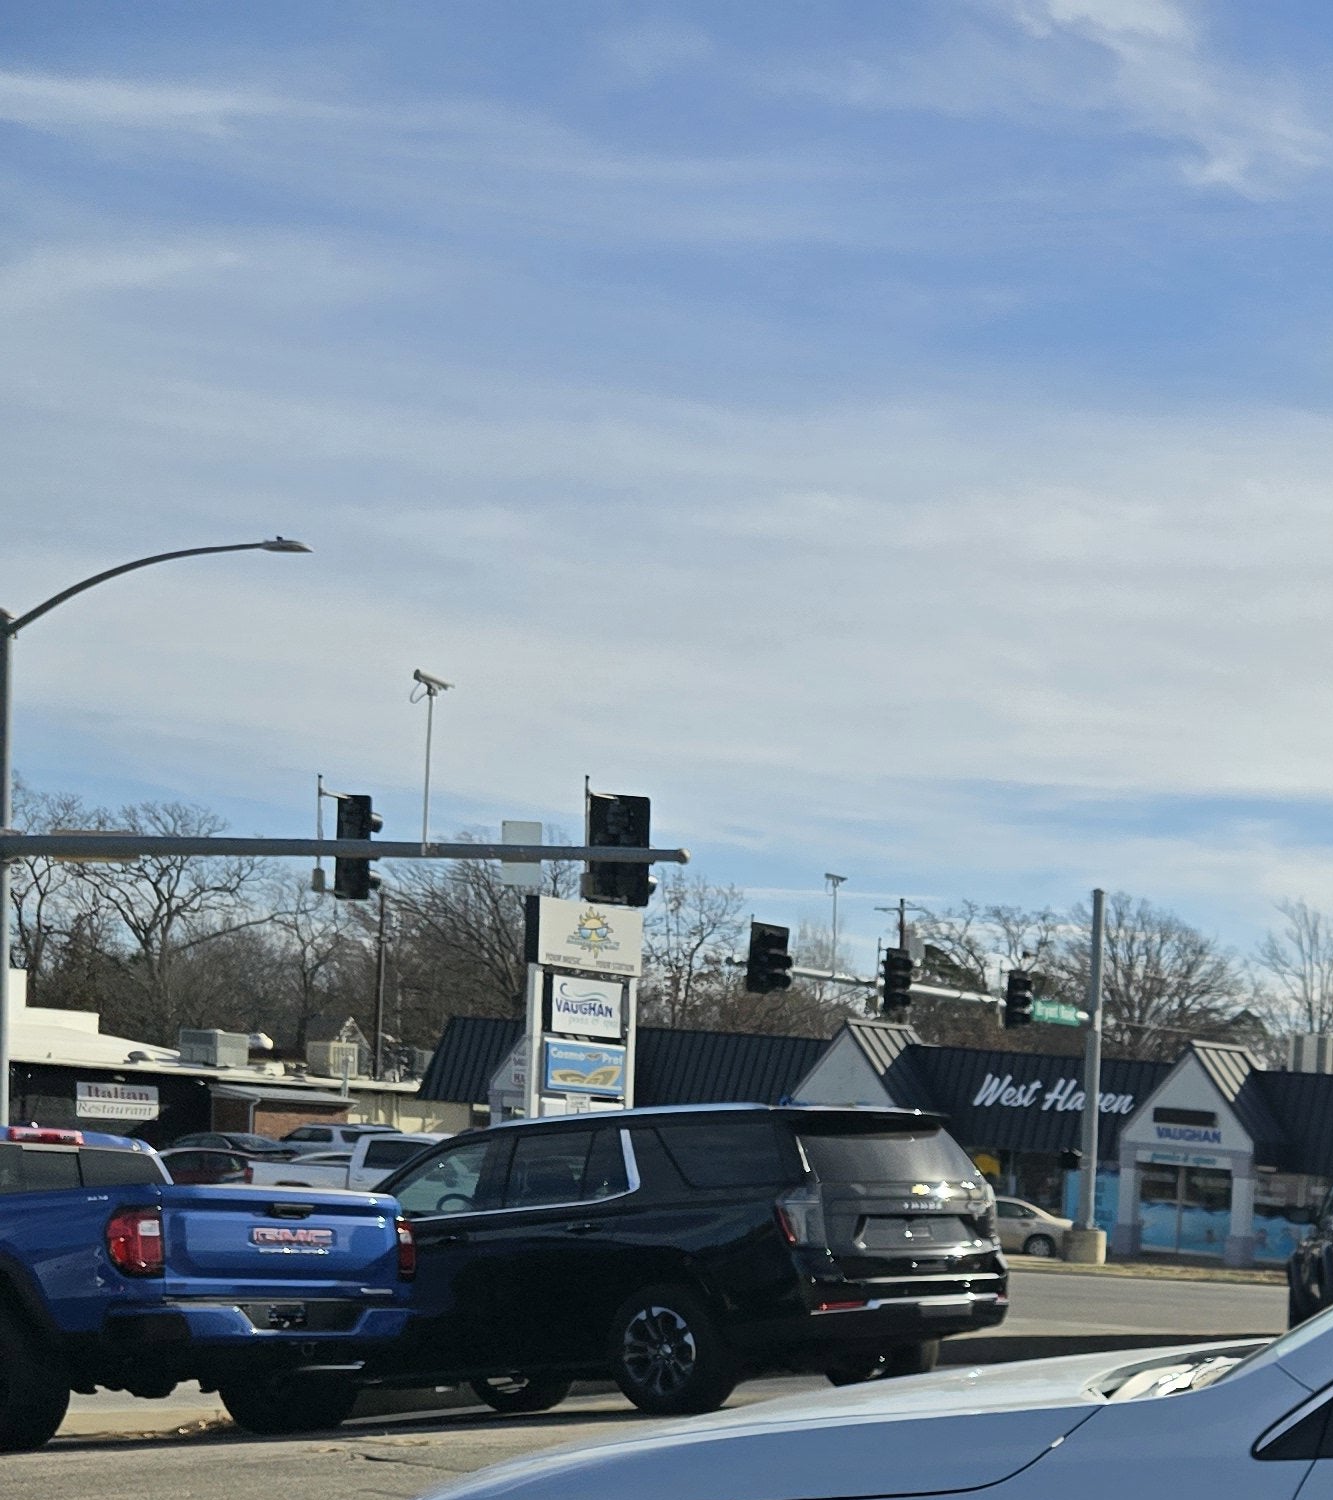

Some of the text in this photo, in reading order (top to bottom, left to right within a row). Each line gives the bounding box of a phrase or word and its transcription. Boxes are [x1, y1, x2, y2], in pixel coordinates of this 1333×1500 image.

[555, 998, 613, 1018] VAUGHAN
[87, 1085, 150, 1101] Italian
[973, 1073, 1042, 1107] West
[78, 1102, 152, 1117] Restaurant
[1155, 1126, 1222, 1144] VAUGHAN
[253, 1227, 333, 1245] GMC
